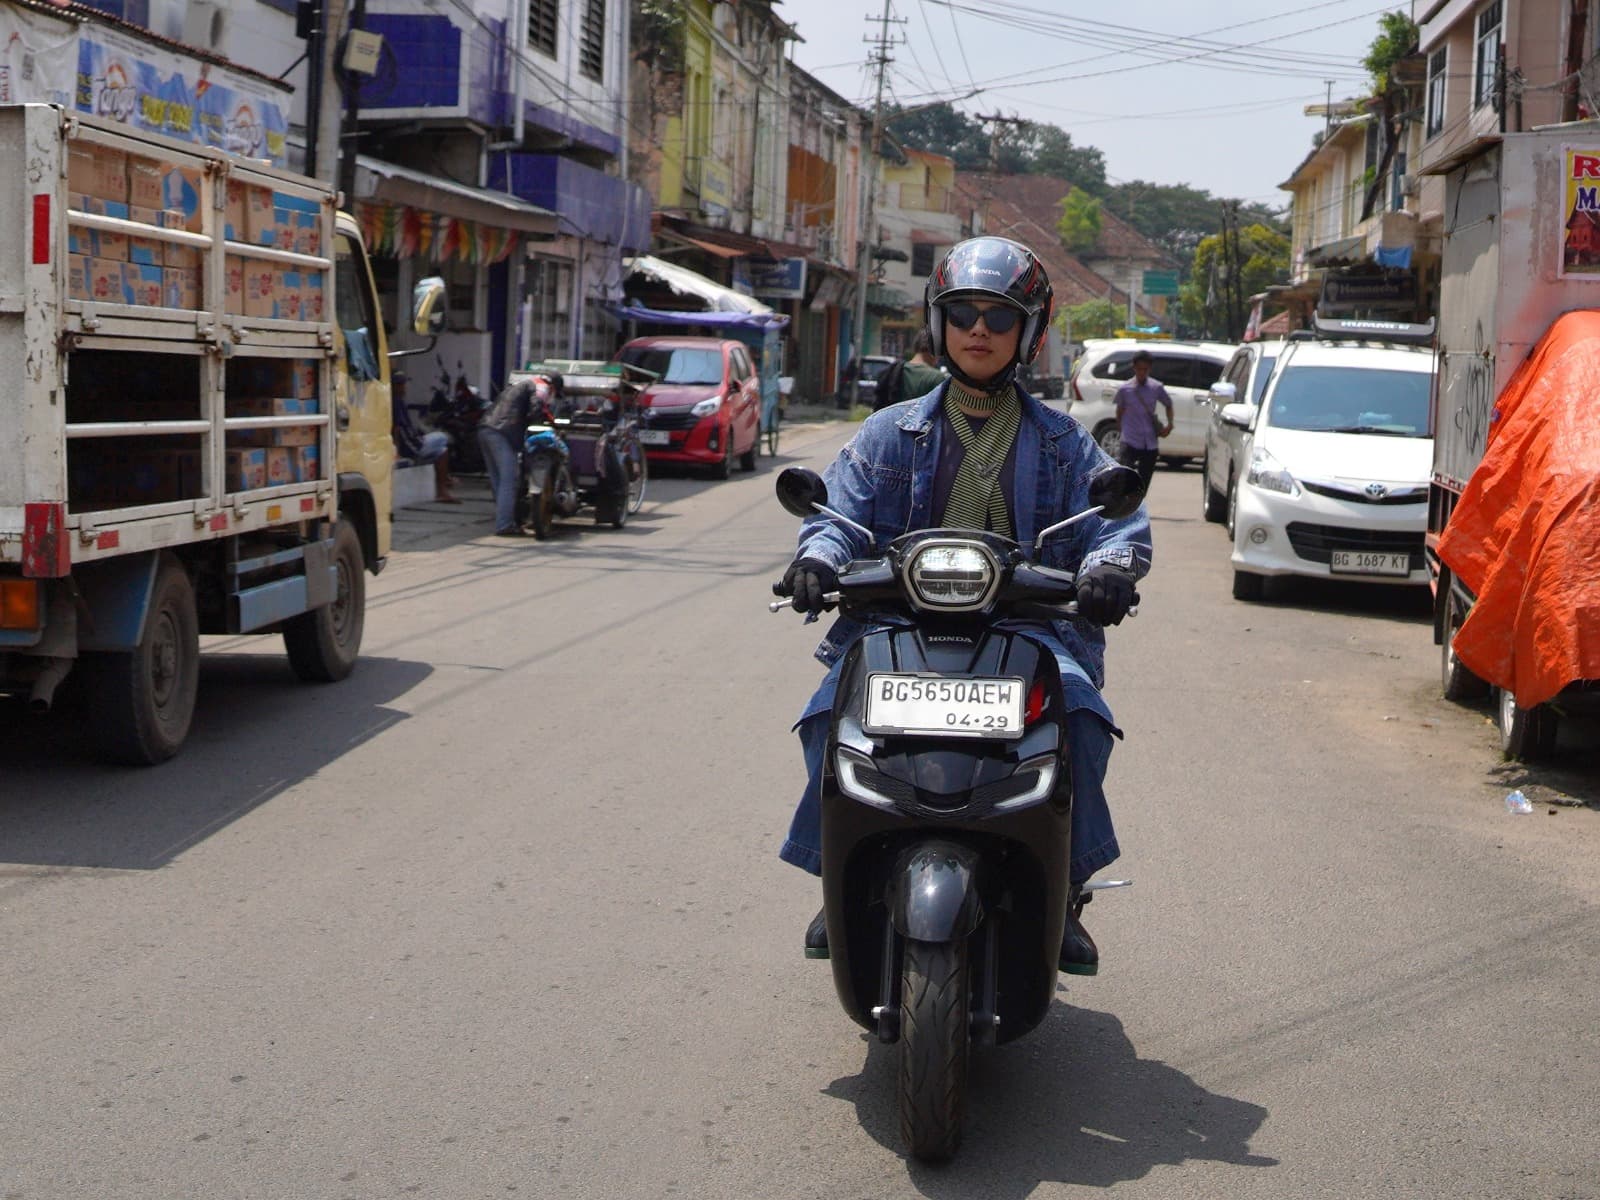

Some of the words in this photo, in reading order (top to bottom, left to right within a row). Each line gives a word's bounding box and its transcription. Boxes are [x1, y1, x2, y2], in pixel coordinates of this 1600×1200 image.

[95, 78, 137, 122] Tango
[1572, 153, 1600, 178] R
[1577, 186, 1600, 210] M
[967, 267, 1001, 276] HONDA
[1333, 553, 1349, 566] BG
[1356, 554, 1386, 567] 1687
[1391, 555, 1409, 568] KT
[928, 636, 973, 644] HONDA
